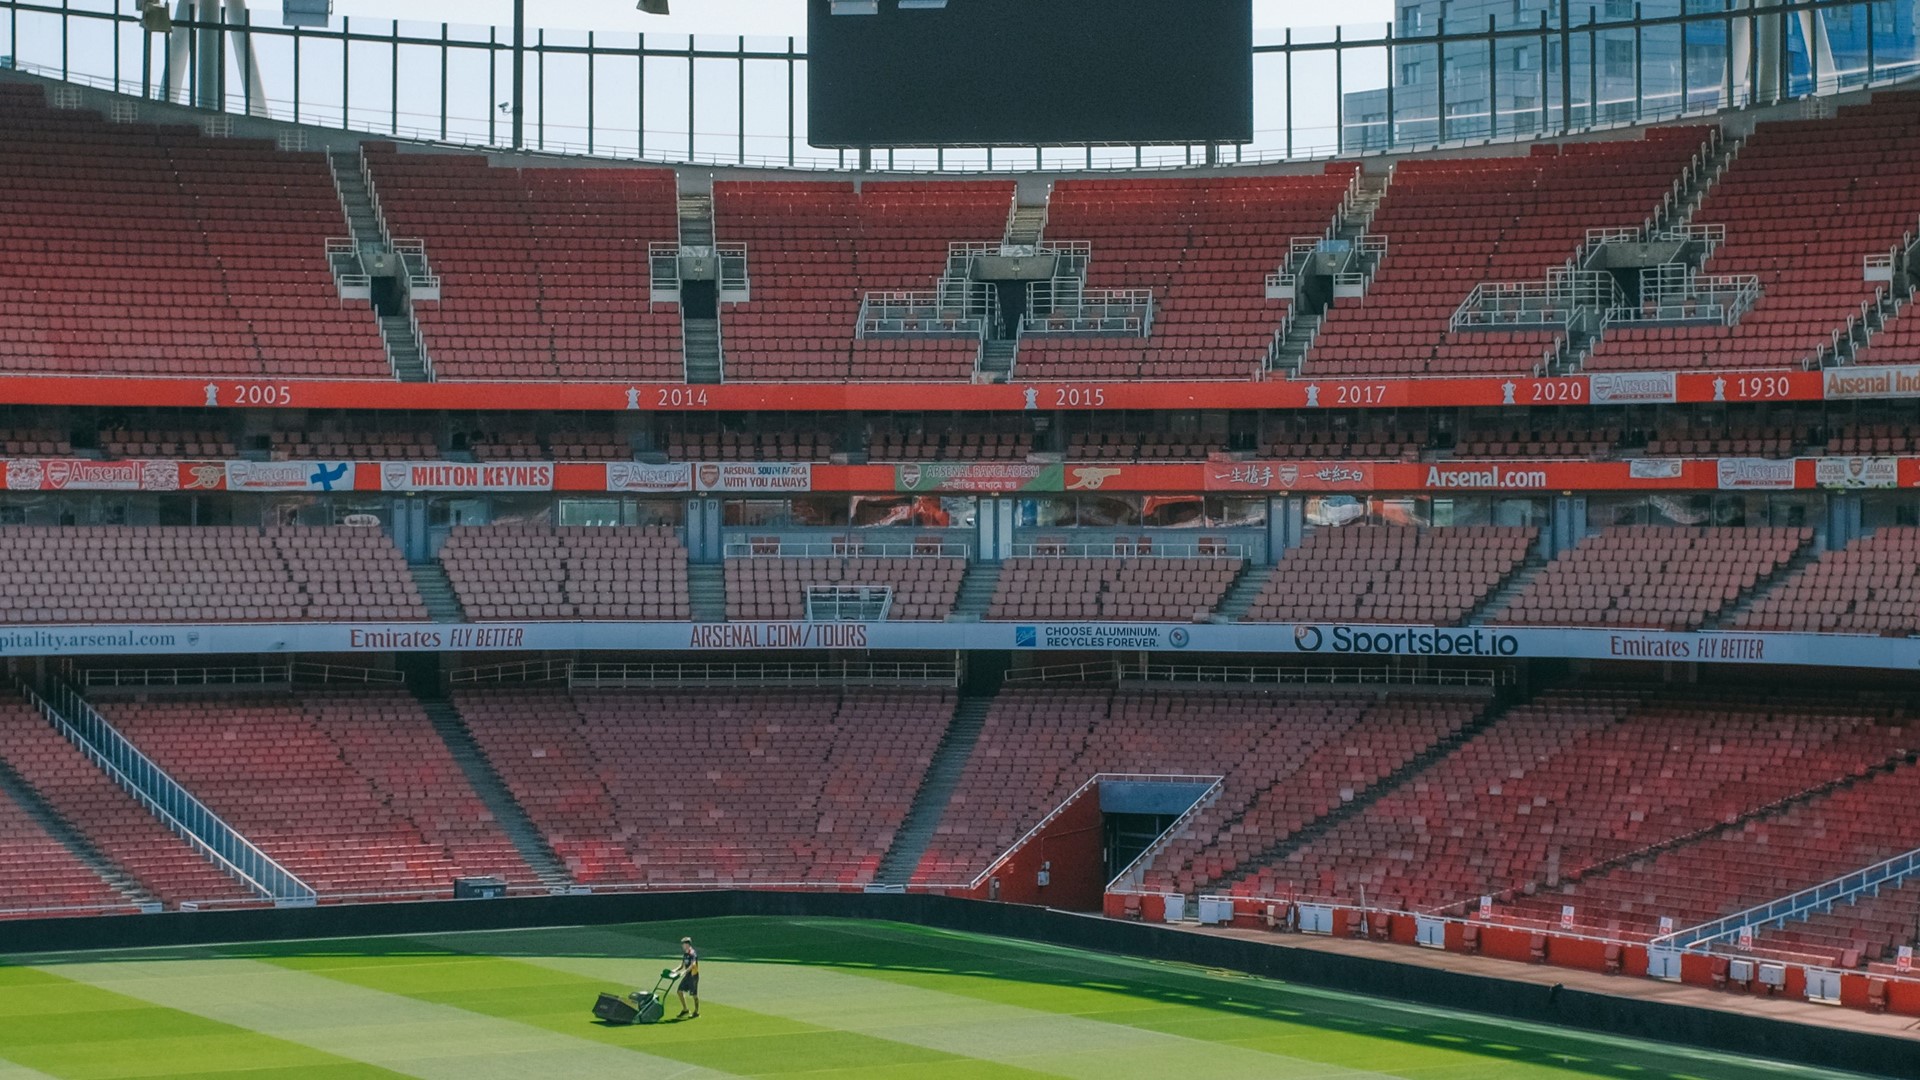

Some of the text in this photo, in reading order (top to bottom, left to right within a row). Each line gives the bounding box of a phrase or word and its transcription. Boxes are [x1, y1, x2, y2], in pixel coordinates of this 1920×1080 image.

[1533, 382, 1581, 400] 2020
[1612, 375, 1673, 393] Arsenal
[1738, 377, 1789, 397] 1930
[1827, 370, 1890, 394] Arsenal
[235, 385, 291, 405] 2005
[658, 389, 708, 406] 2014
[1056, 388, 1104, 406] 2015
[1337, 385, 1386, 403] 2017
[70, 461, 139, 482] Arsenal
[249, 463, 307, 480] Arsenal
[412, 466, 550, 486] MILTON KEYNES
[629, 465, 689, 483] Arsenal
[723, 466, 755, 475] ARSENAL
[782, 466, 807, 475] AFRICA
[926, 465, 1040, 478] ARSENAL BANGLADESH
[1215, 465, 1274, 487] 一生槍手
[1302, 465, 1363, 482] 一世紅白
[1425, 465, 1547, 487] Arsenal.com
[1736, 460, 1793, 478] Arsenal
[724, 477, 807, 488] WITH YOU ALWAYS
[350, 628, 524, 648] Emirates FLY BETTER
[690, 624, 867, 648] ARSENAL.COM/TOURS
[1045, 626, 1161, 637] CHOOSE ALUMINIUM.
[1046, 637, 1159, 648] RECYCLES FOREVER.
[1332, 626, 1518, 656] Sportsbet.io
[1610, 635, 1764, 660] Emirates FLY BETTER
